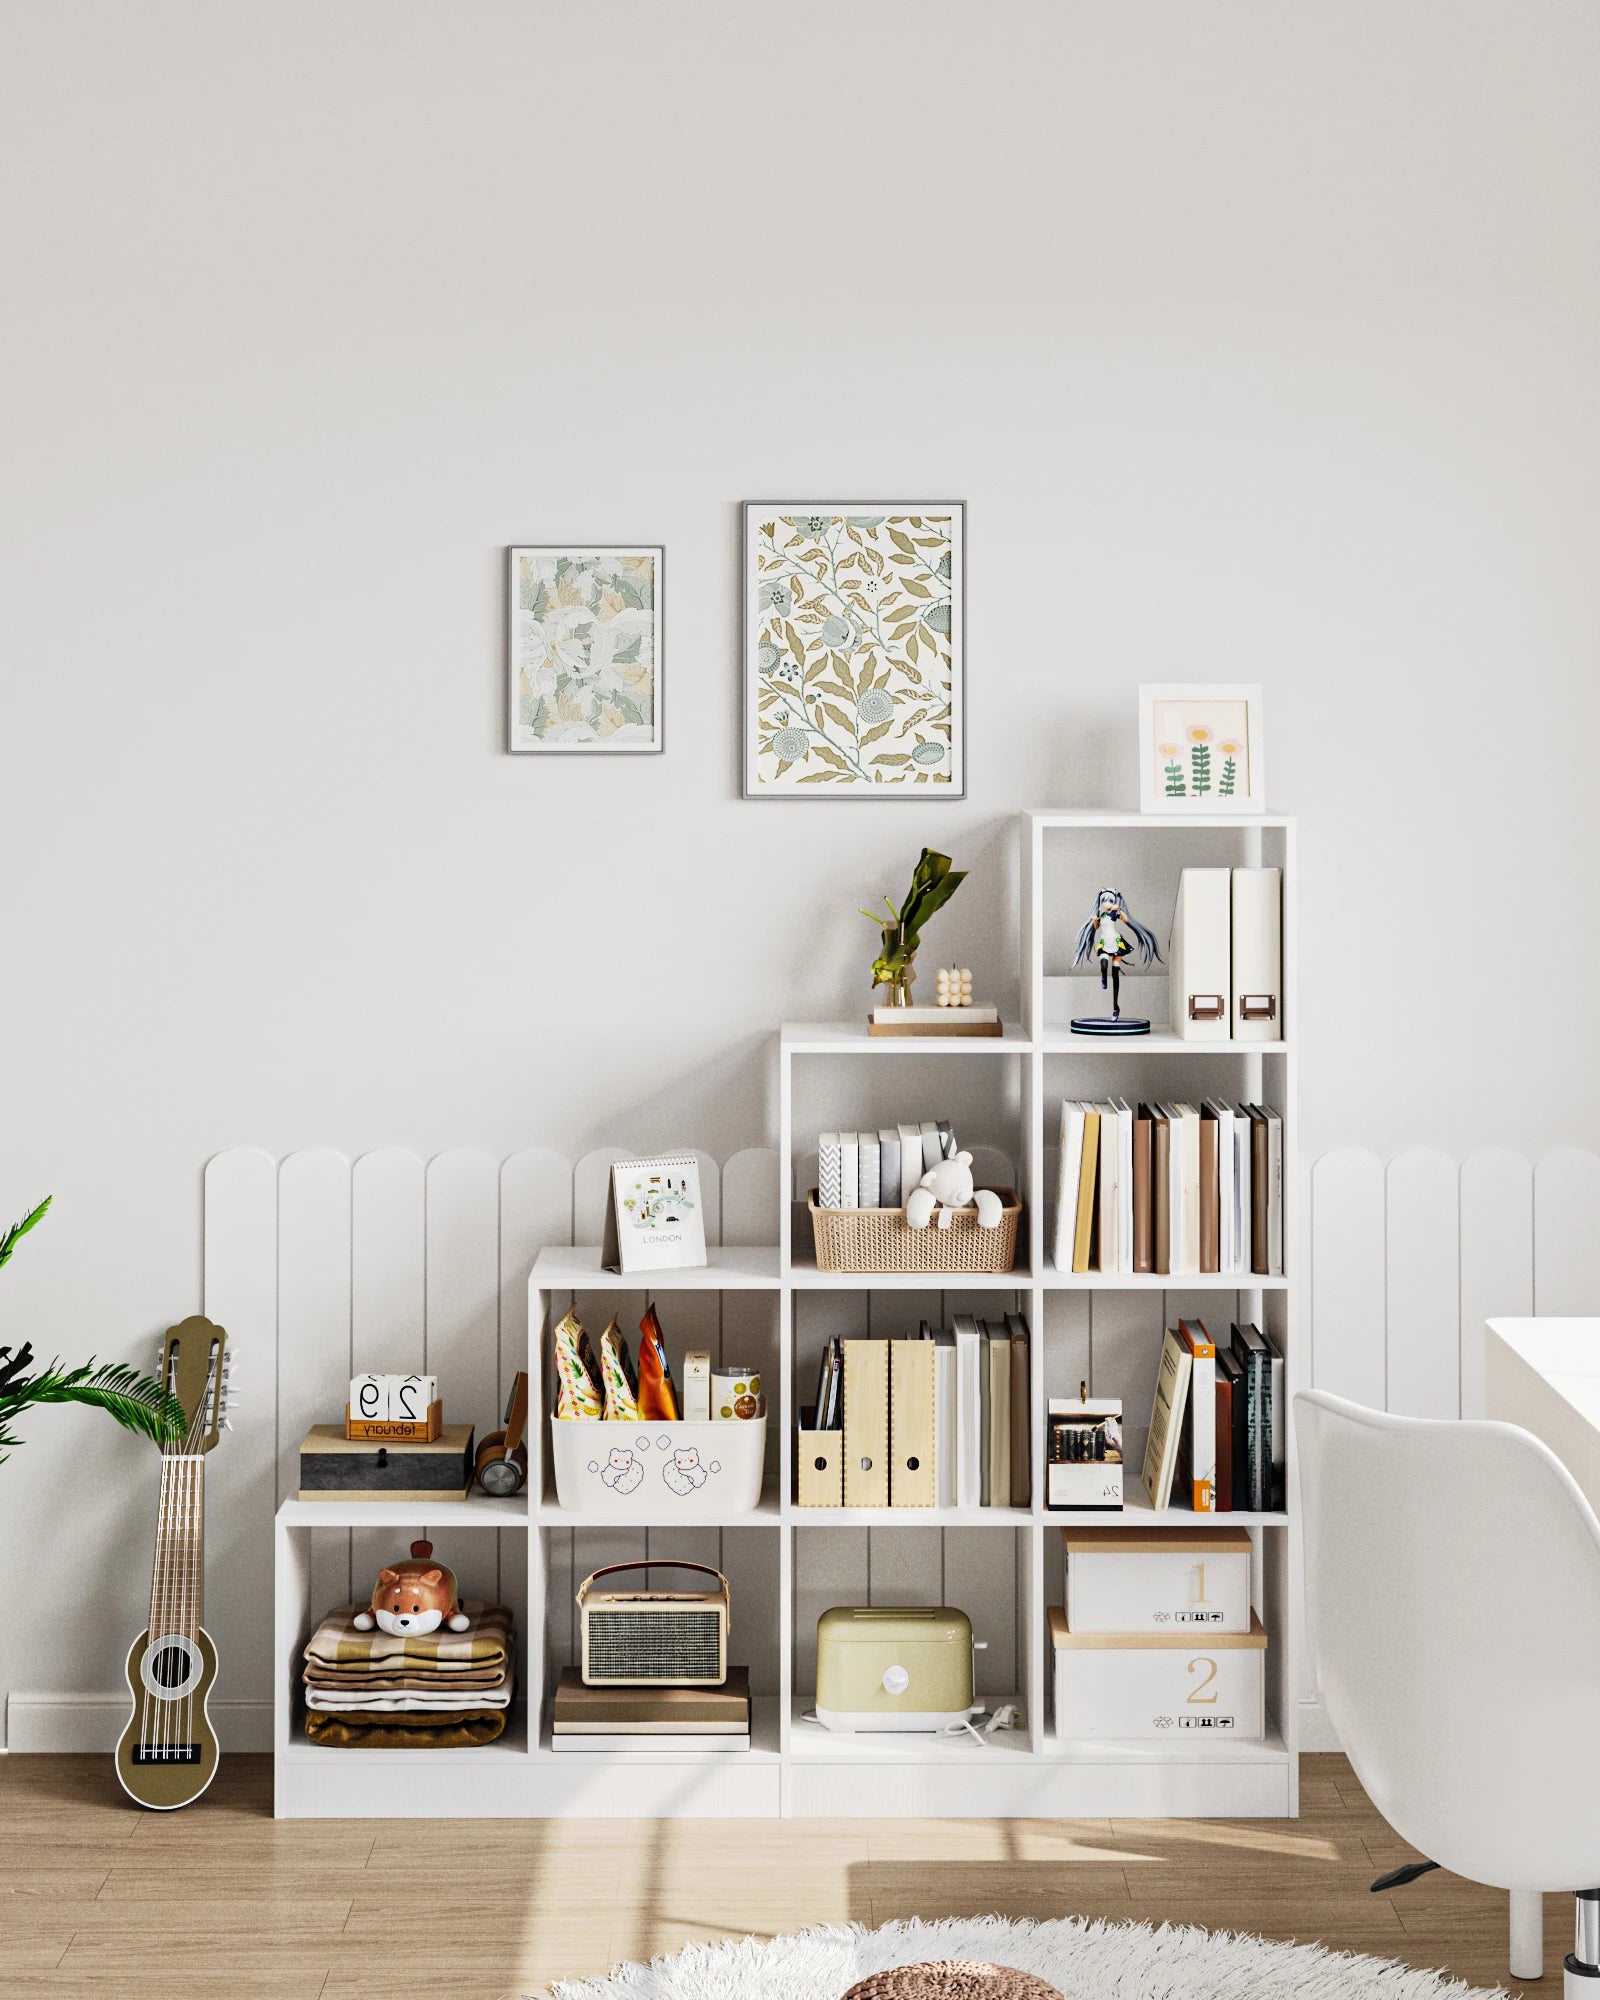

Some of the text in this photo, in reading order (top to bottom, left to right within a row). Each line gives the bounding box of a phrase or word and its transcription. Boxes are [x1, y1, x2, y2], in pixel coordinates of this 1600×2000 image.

[643, 1234, 682, 1244] LONDON
[1191, 1562, 1212, 1603] 1
[1186, 1657, 1219, 1703] 2
